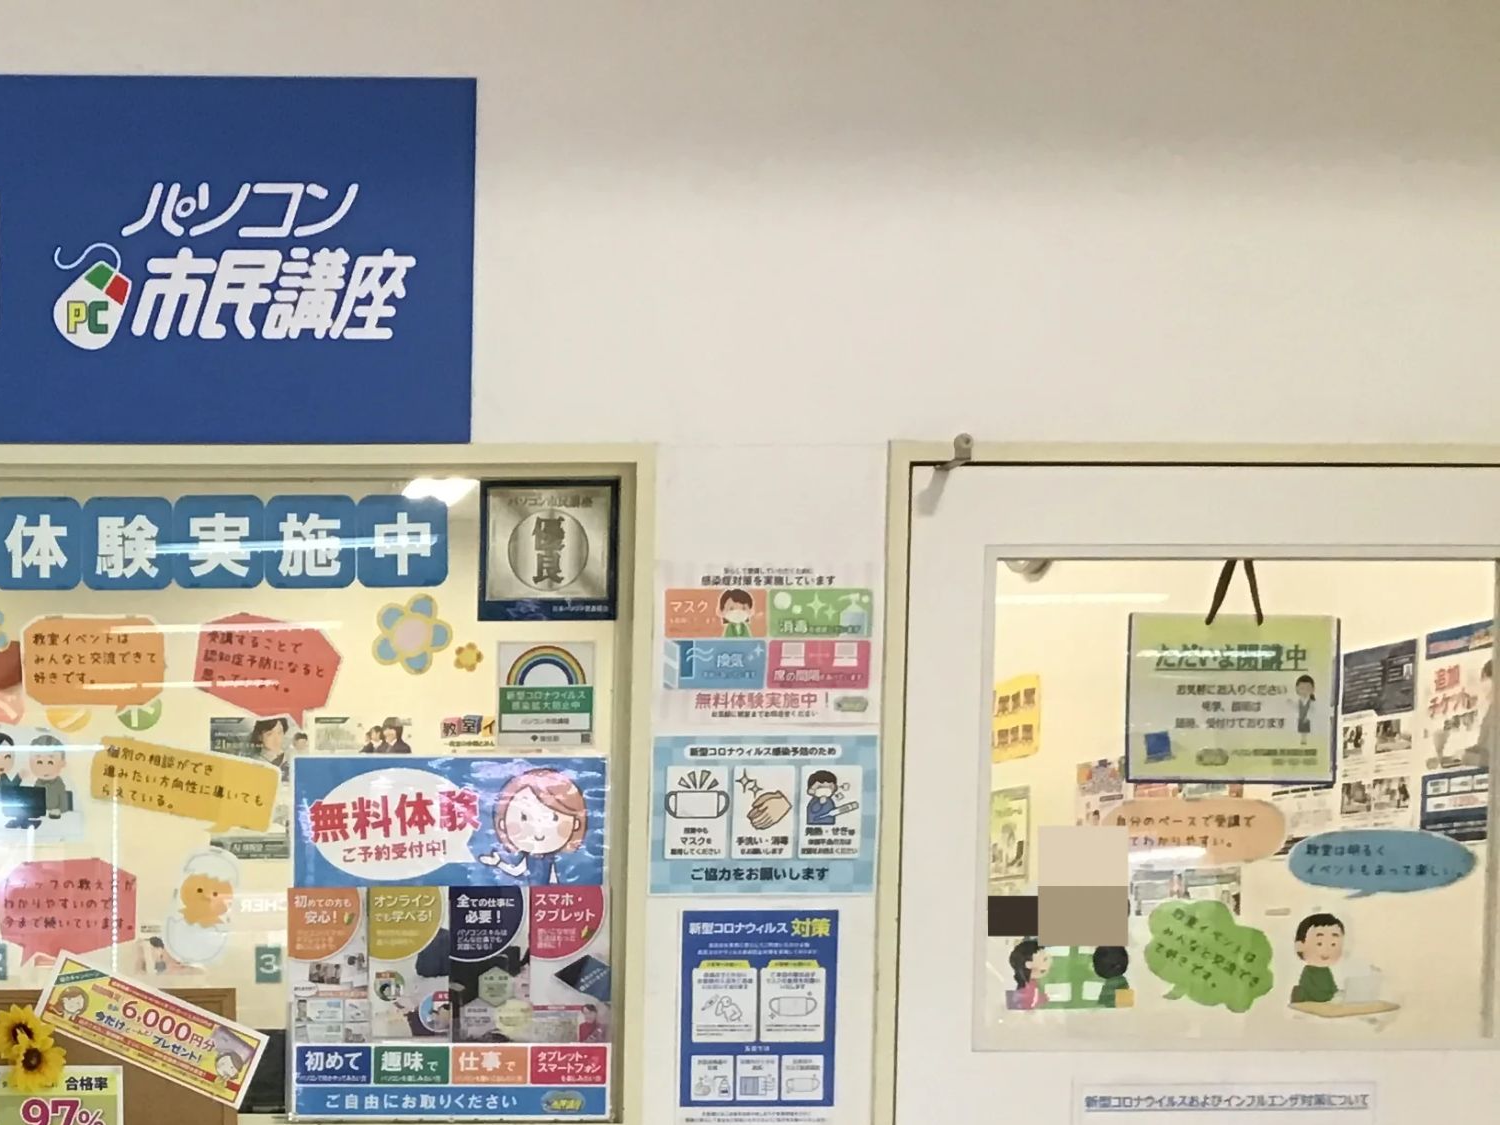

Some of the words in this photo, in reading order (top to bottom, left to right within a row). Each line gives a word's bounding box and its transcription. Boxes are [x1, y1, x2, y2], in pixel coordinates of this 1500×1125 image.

[121, 182, 359, 238] パソコン
[131, 247, 417, 341] 市民講座
[66, 301, 109, 335] PC
[701, 575, 836, 586] 感染症対策を実施しています
[669, 600, 709, 614] マスク
[32, 631, 129, 646] 教室イベントは
[206, 629, 303, 653] 受講することで
[33, 650, 157, 665] みんなと交流できて
[202, 649, 325, 678] 認知症予防になると
[716, 652, 745, 668] 換気
[33, 671, 97, 685] 好きです。
[695, 692, 830, 710] 無料体験実施中!
[309, 787, 483, 843] 無料体験
[1116, 814, 1256, 828] 自分のペースで受講で
[736, 836, 789, 846] 手洗い・消毒
[342, 840, 447, 863] ご予約受付中!
[1306, 843, 1386, 857] 教室は明るく
[690, 867, 830, 882] ご協力をお願いします
[294, 894, 352, 908] 初めての方も
[374, 895, 435, 906] オンライン
[456, 894, 515, 909] 全ての仕事に
[304, 909, 338, 923] 安心!
[374, 910, 434, 923] でも学べる!
[465, 909, 501, 924] 必要!
[535, 908, 596, 922] タブレット
[790, 917, 831, 938] 対策
[259, 954, 279, 974] 3
[121, 1000, 216, 1052] 6,000円分
[94, 1011, 126, 1031] 今だけ
[152, 1034, 203, 1064] プレゼント!
[304, 1050, 363, 1073] 初めて
[381, 1050, 439, 1073] 趣味で
[458, 1051, 516, 1073] 仕事で
[537, 1062, 602, 1074] スマートフォン
[65, 1077, 108, 1091] 合格率
[325, 1092, 518, 1111] ご自由にお取りください
